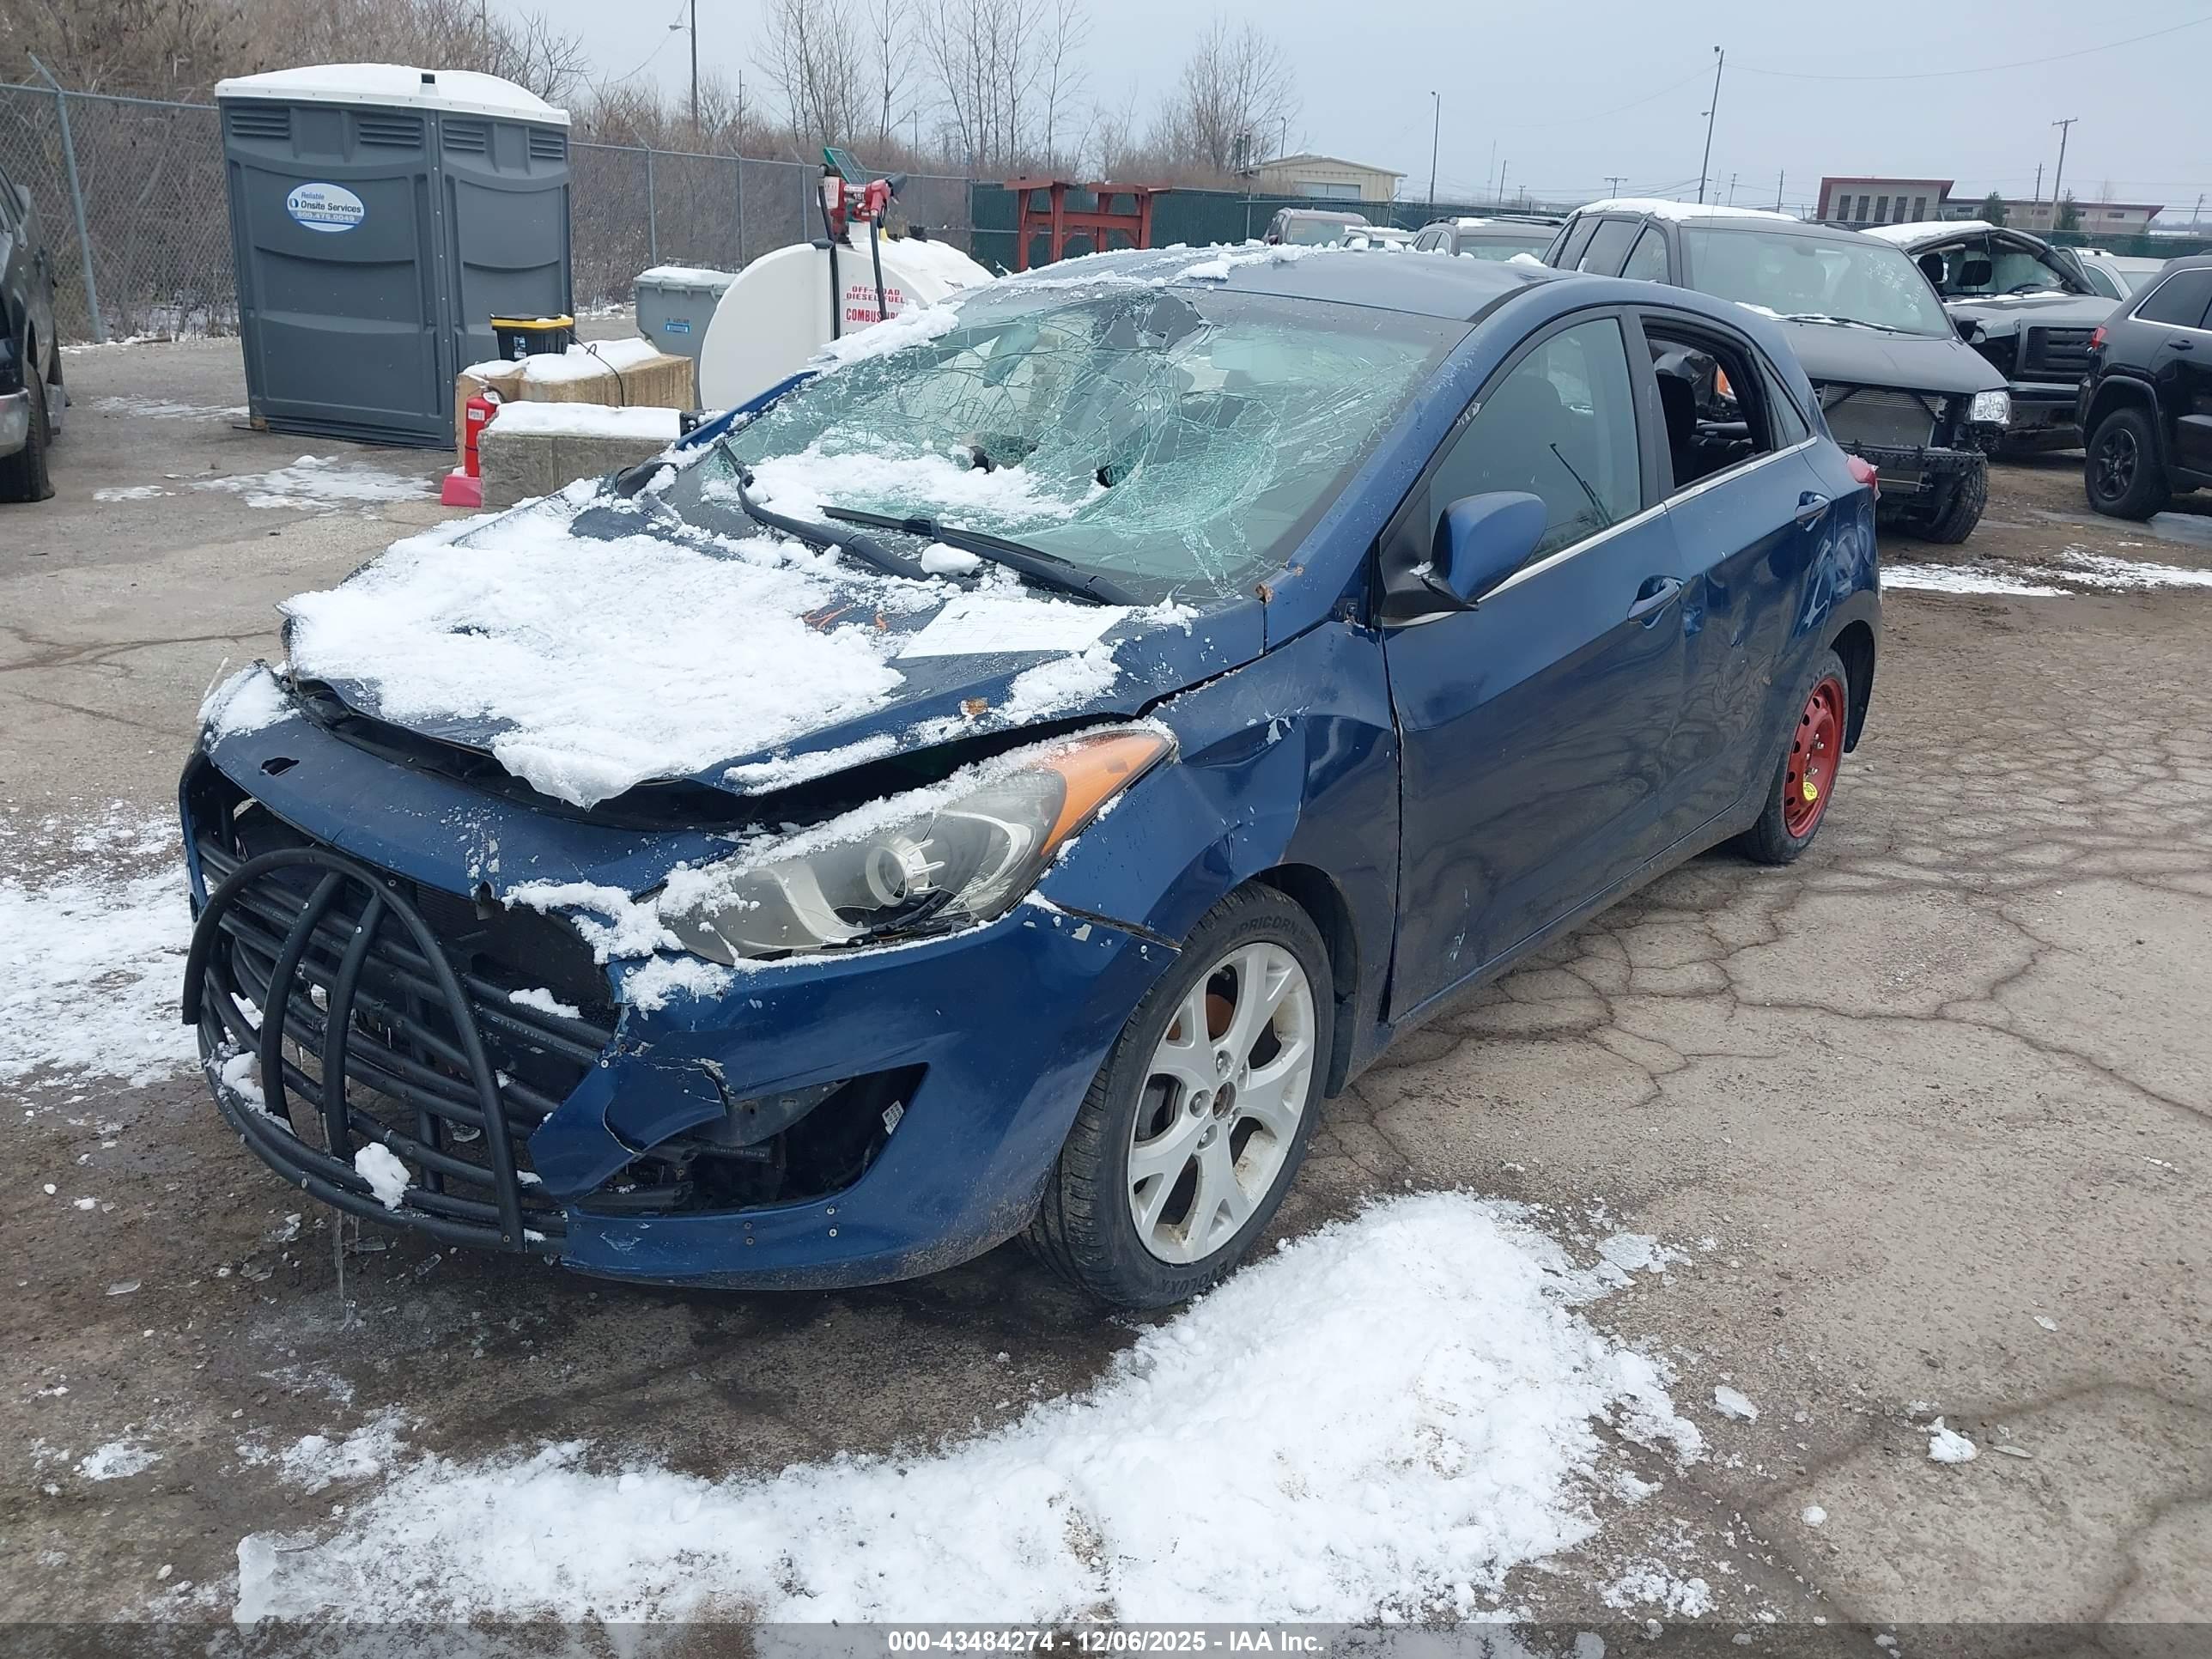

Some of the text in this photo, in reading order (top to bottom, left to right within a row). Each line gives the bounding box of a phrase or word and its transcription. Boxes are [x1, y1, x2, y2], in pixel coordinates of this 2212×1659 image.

[301, 191, 325, 200] Reliable
[301, 200, 362, 214] Onsite Services
[846, 293, 879, 302] DIESEL
[1219, 915, 1299, 944] APRICORN
